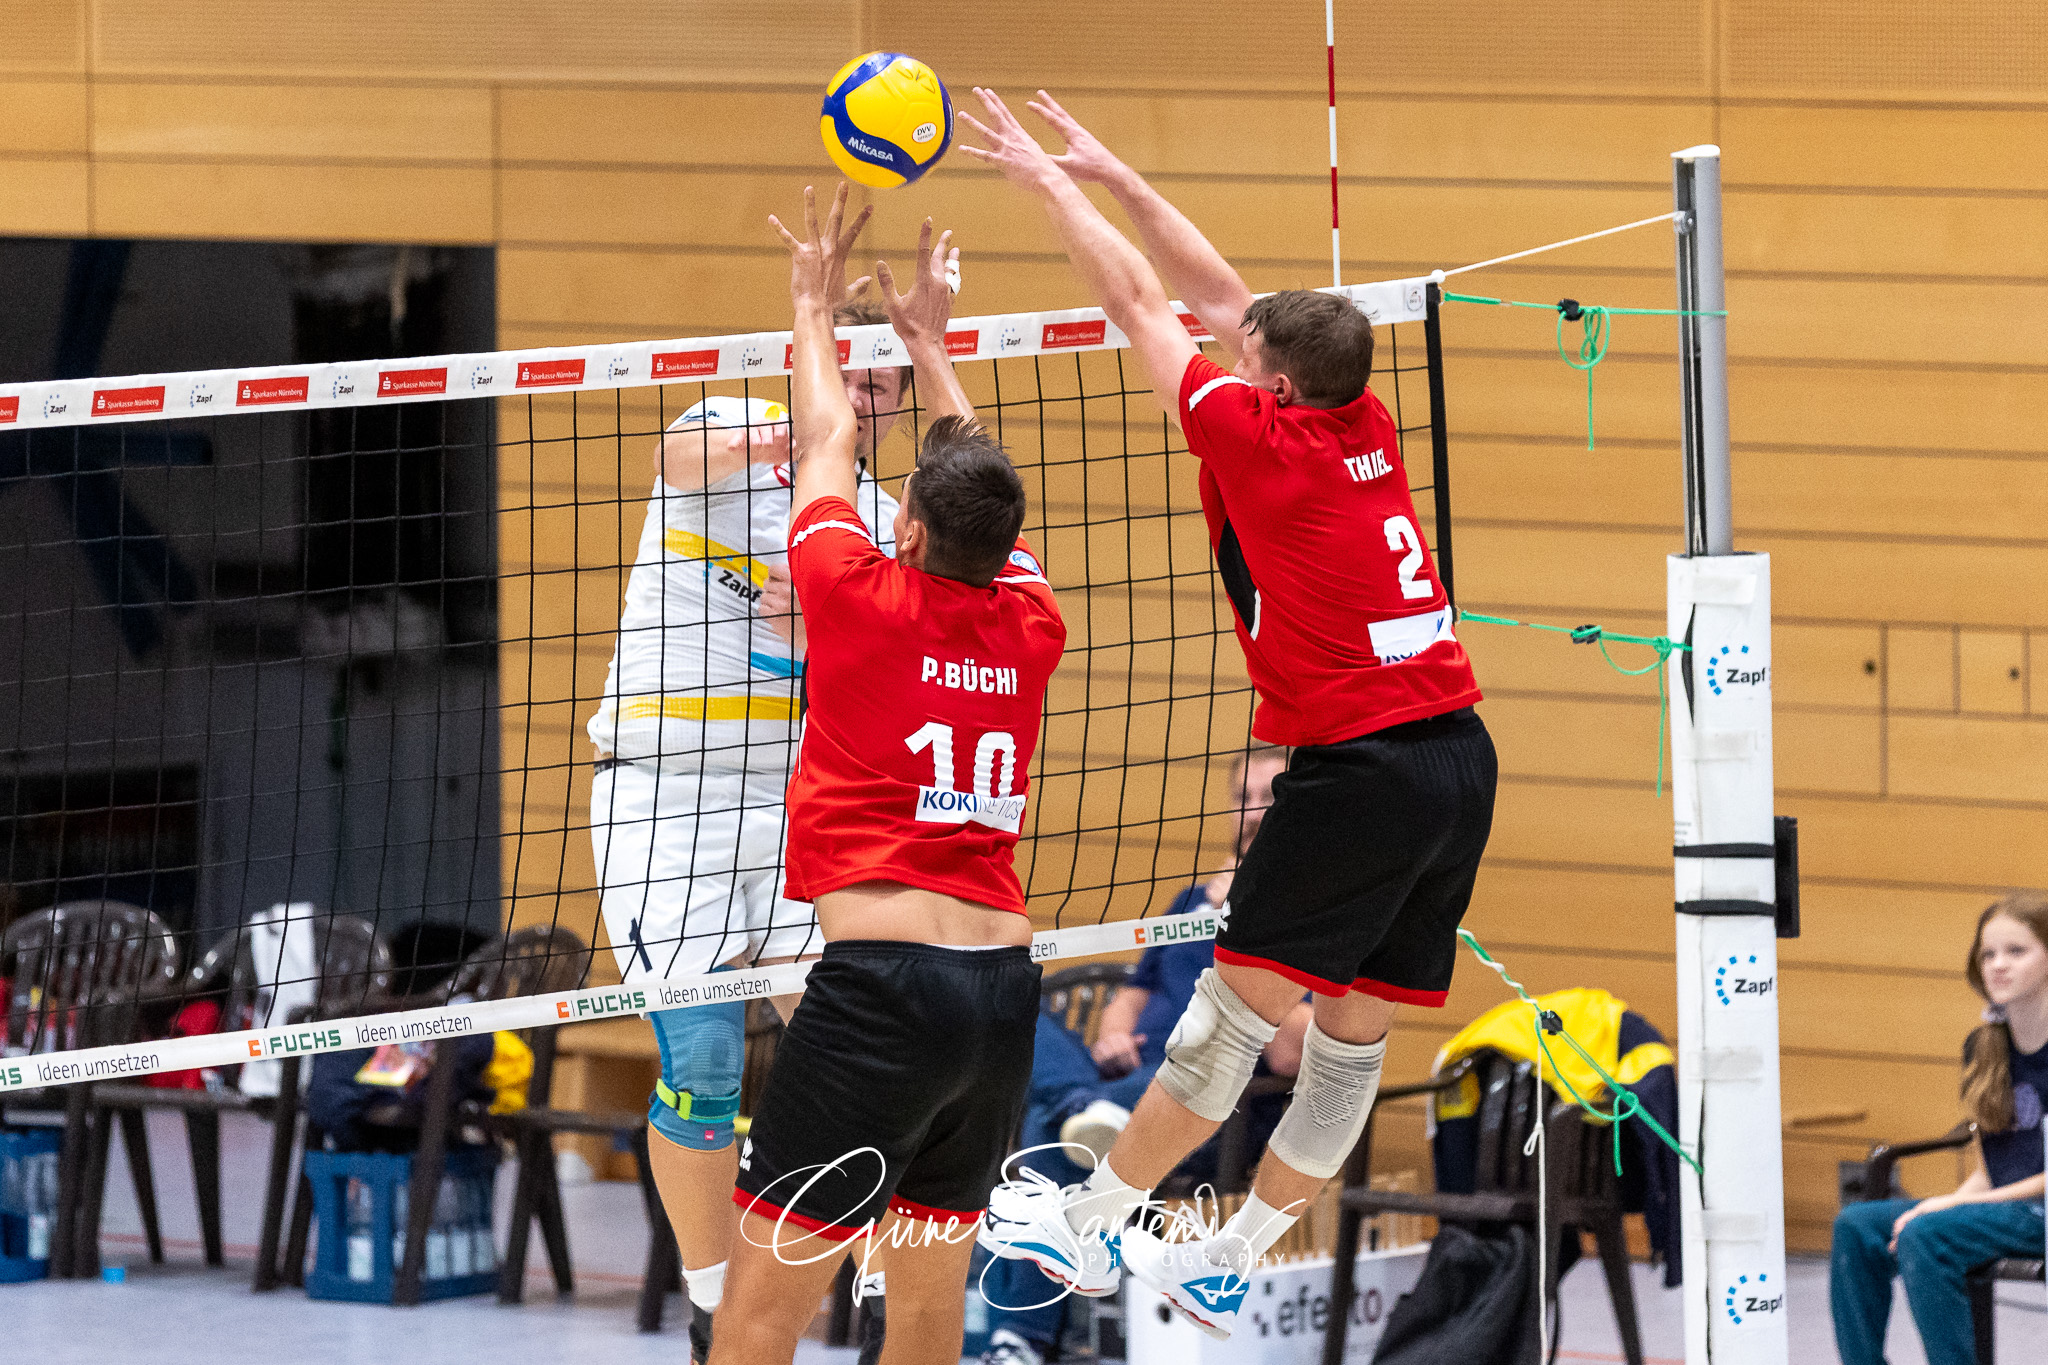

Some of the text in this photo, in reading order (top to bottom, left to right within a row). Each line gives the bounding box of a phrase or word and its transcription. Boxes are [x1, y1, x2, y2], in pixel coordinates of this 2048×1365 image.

[917, 124, 932, 136] DVV
[1006, 338, 1021, 346] Zapf
[877, 347, 893, 356] Zapf
[747, 357, 763, 366] Zapf
[613, 367, 629, 376] Zapf
[665, 363, 691, 372] Sparkasse
[477, 376, 493, 385] Zapf
[530, 372, 556, 381] Sparkasse
[556, 371, 580, 379] Nürnberg
[338, 385, 355, 394] Zapf
[392, 382, 418, 390] Sparkasse
[418, 379, 443, 389] Nürnberg
[196, 394, 213, 403] Zapf
[252, 390, 278, 399] Sparkasse
[278, 388, 303, 397] Nürnberg
[50, 404, 67, 414] Zapf
[107, 401, 134, 409] Sparkasse
[1343, 447, 1394, 483] THIEL
[1383, 514, 1434, 600] 2
[717, 569, 763, 603] Zapf
[921, 655, 1018, 695] P.BÜCHI
[904, 721, 1017, 799] 10
[1153, 919, 1216, 942] FUCHS
[577, 977, 772, 1016] FUCHS Ideen umsetzen
[269, 1014, 472, 1054] FUCHS Ideen umsetzen
[37, 1060, 81, 1082] Ideen
[85, 1051, 160, 1076] umsetzen
